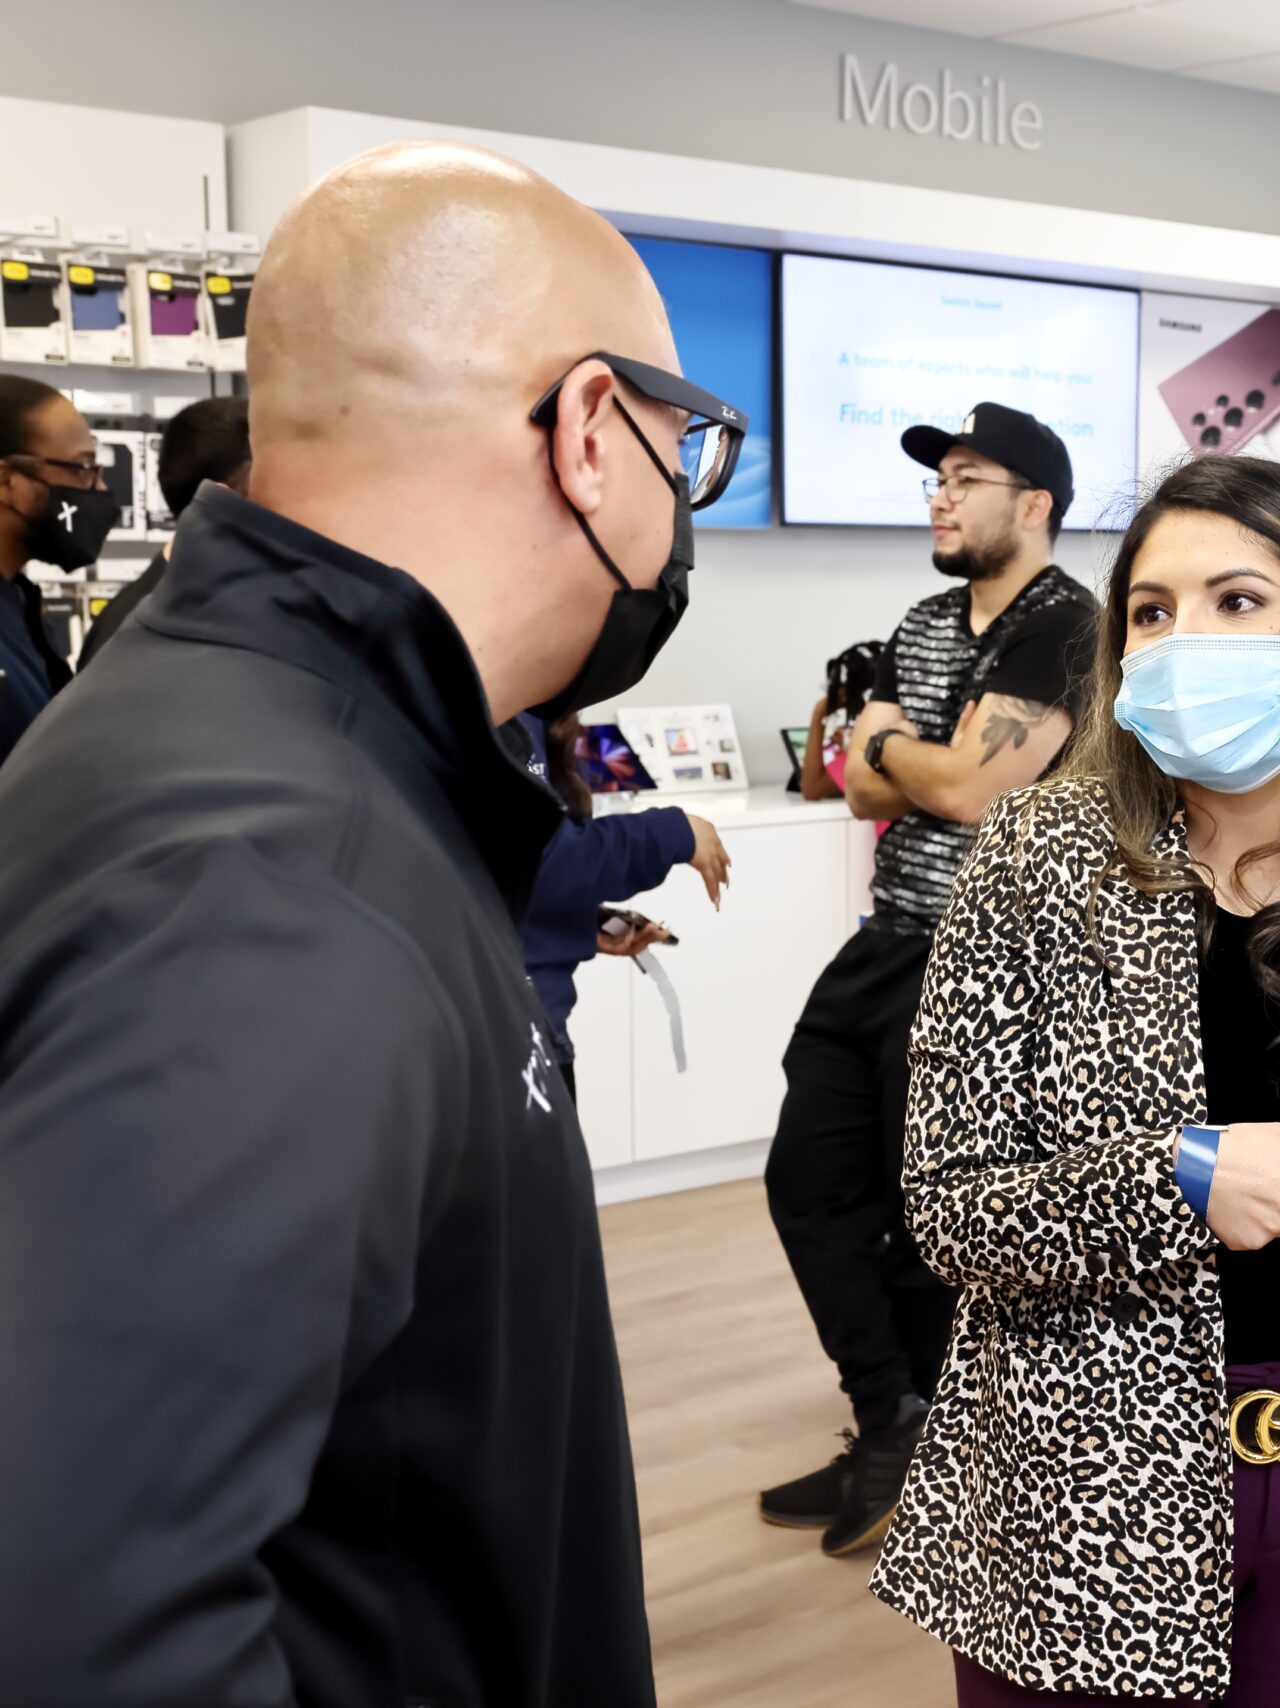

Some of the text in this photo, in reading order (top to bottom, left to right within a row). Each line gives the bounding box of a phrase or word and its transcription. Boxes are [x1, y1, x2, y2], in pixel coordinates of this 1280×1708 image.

[841, 53, 1043, 150] Mobile
[838, 352, 849, 366] A
[1009, 364, 1030, 378] will
[839, 404, 883, 425] Find
[890, 407, 925, 426] the
